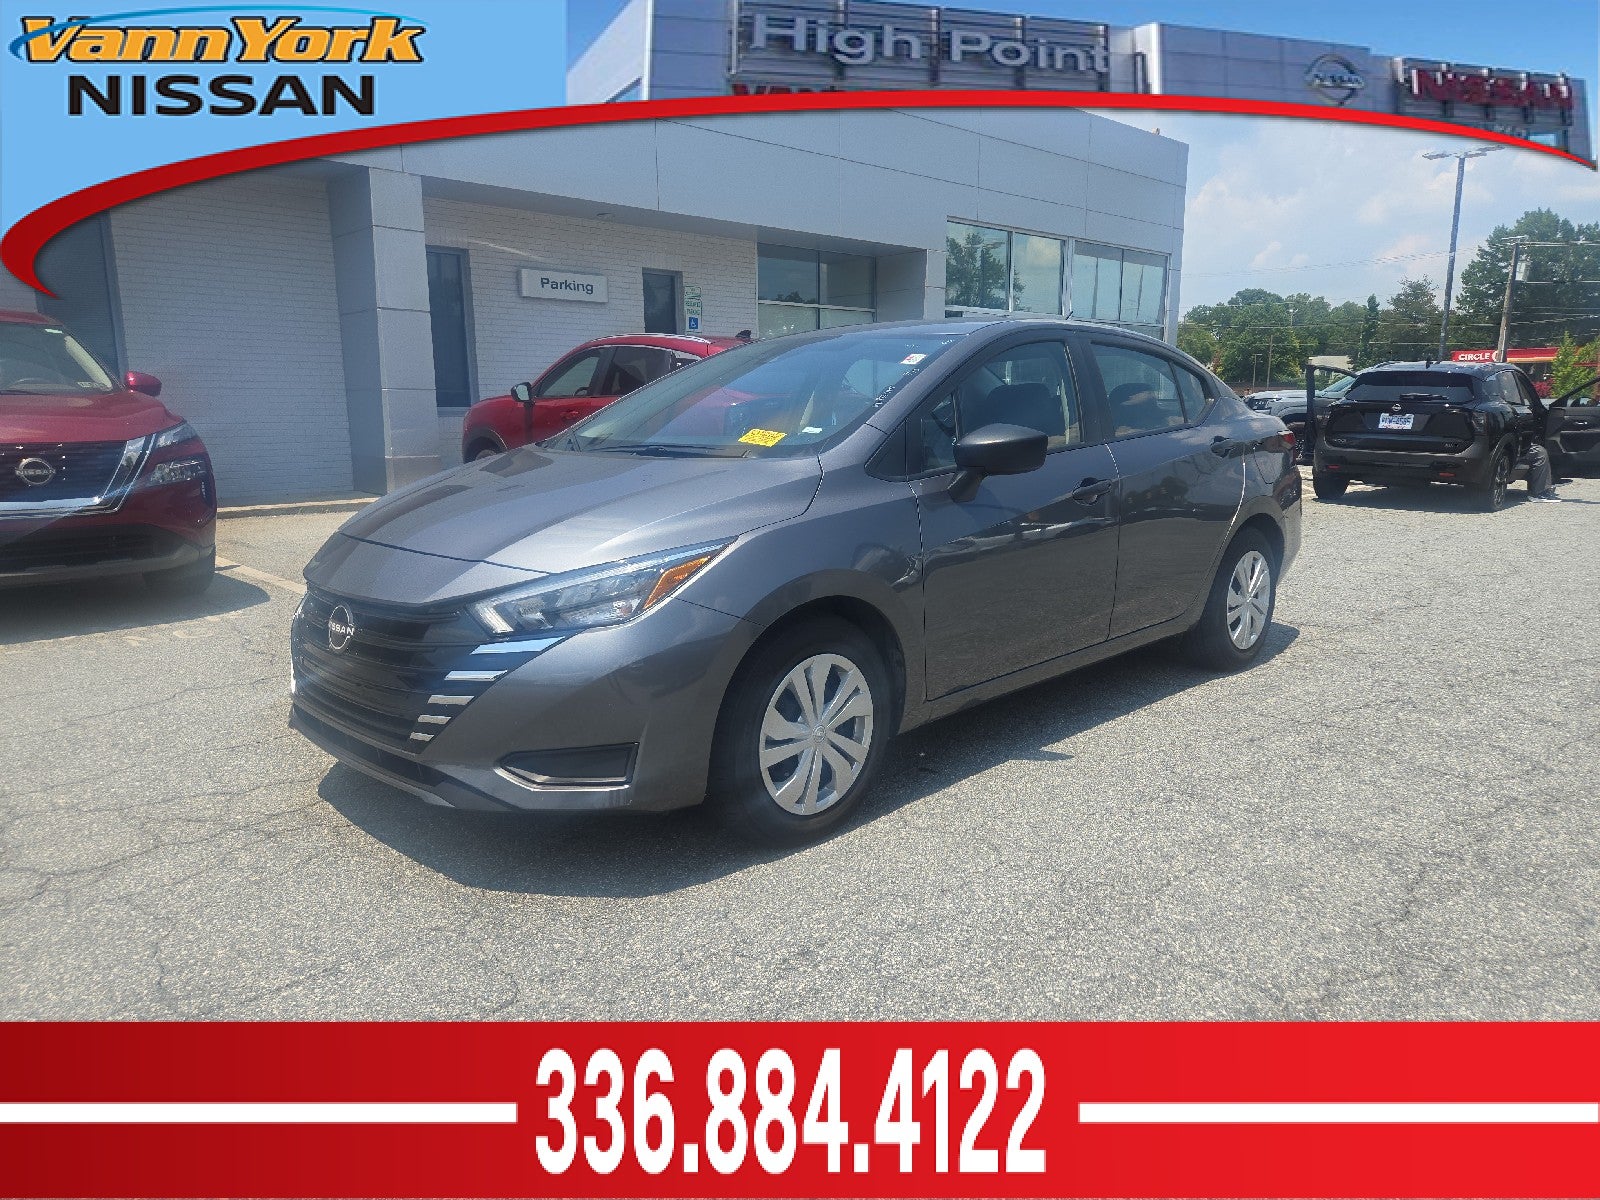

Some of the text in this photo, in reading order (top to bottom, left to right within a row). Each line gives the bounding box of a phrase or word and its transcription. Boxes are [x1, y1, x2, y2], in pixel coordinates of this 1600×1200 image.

[540, 277, 594, 294] Parking
[1458, 352, 1491, 361] CIRCLE
[15, 468, 56, 476] NISSAN
